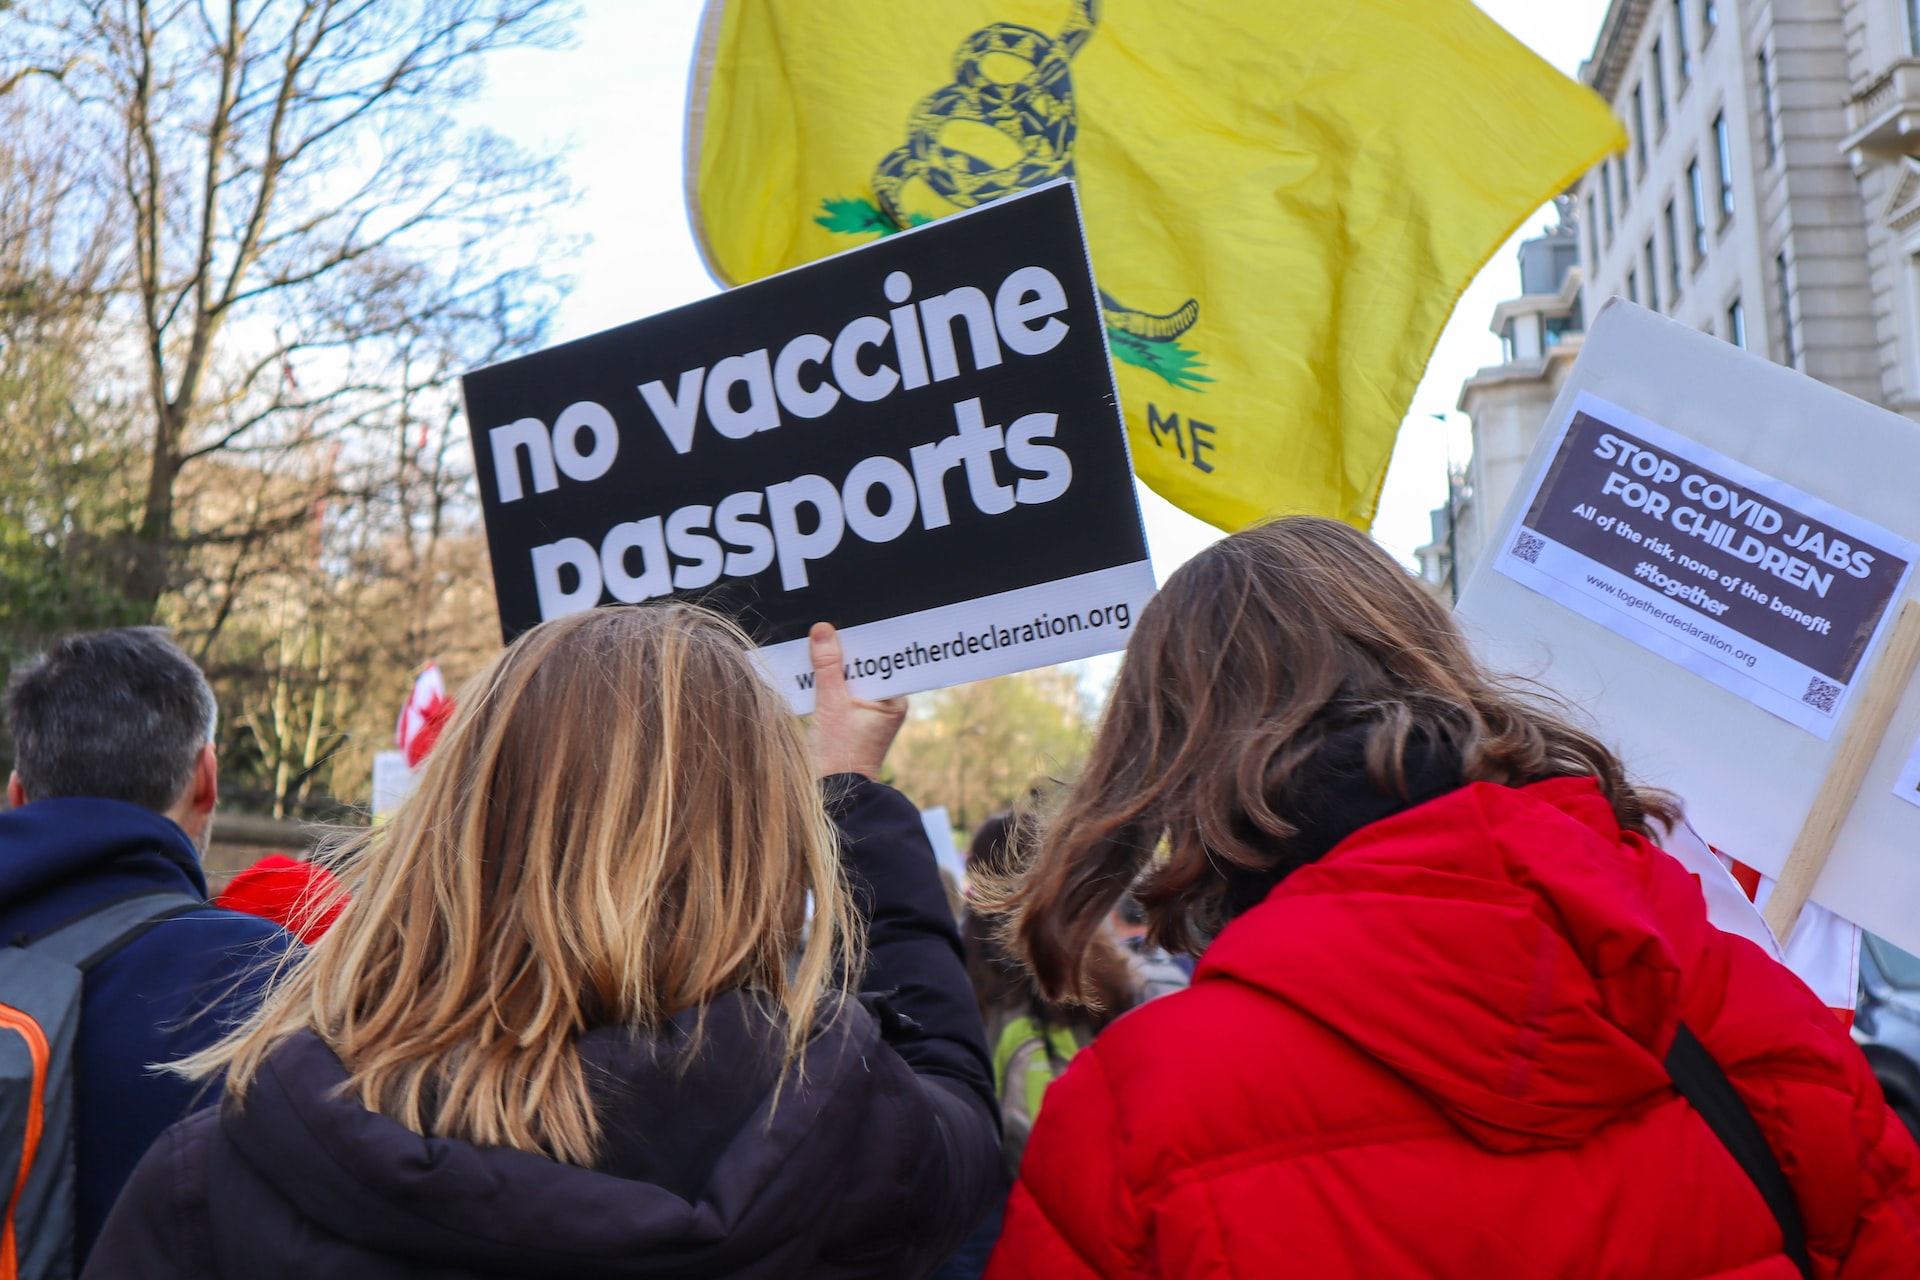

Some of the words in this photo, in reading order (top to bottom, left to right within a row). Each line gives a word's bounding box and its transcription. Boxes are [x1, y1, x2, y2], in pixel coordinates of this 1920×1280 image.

[489, 401, 619, 503] no
[638, 266, 1070, 454] vaccine
[1148, 402, 1216, 474] ME
[531, 397, 1073, 621] passports
[1572, 503, 1597, 521] All
[1596, 515, 1617, 532] of
[1615, 521, 1643, 543] the
[1642, 537, 1675, 562] risk,
[1677, 554, 1719, 580] none
[1719, 575, 1741, 592] of
[1740, 581, 1769, 605] the
[1769, 596, 1832, 636] benefit
[1593, 433, 1681, 484] STOP
[1681, 474, 1783, 535] COVID
[1782, 523, 1876, 579] JABS
[1601, 471, 1671, 521] FOR
[1671, 506, 1835, 598] CHILDREN
[795, 602, 1131, 690] w.togetherdeclaration.org
[1587, 574, 1757, 668] www.togetherdeclaration.org
[1634, 561, 1730, 616] #together
